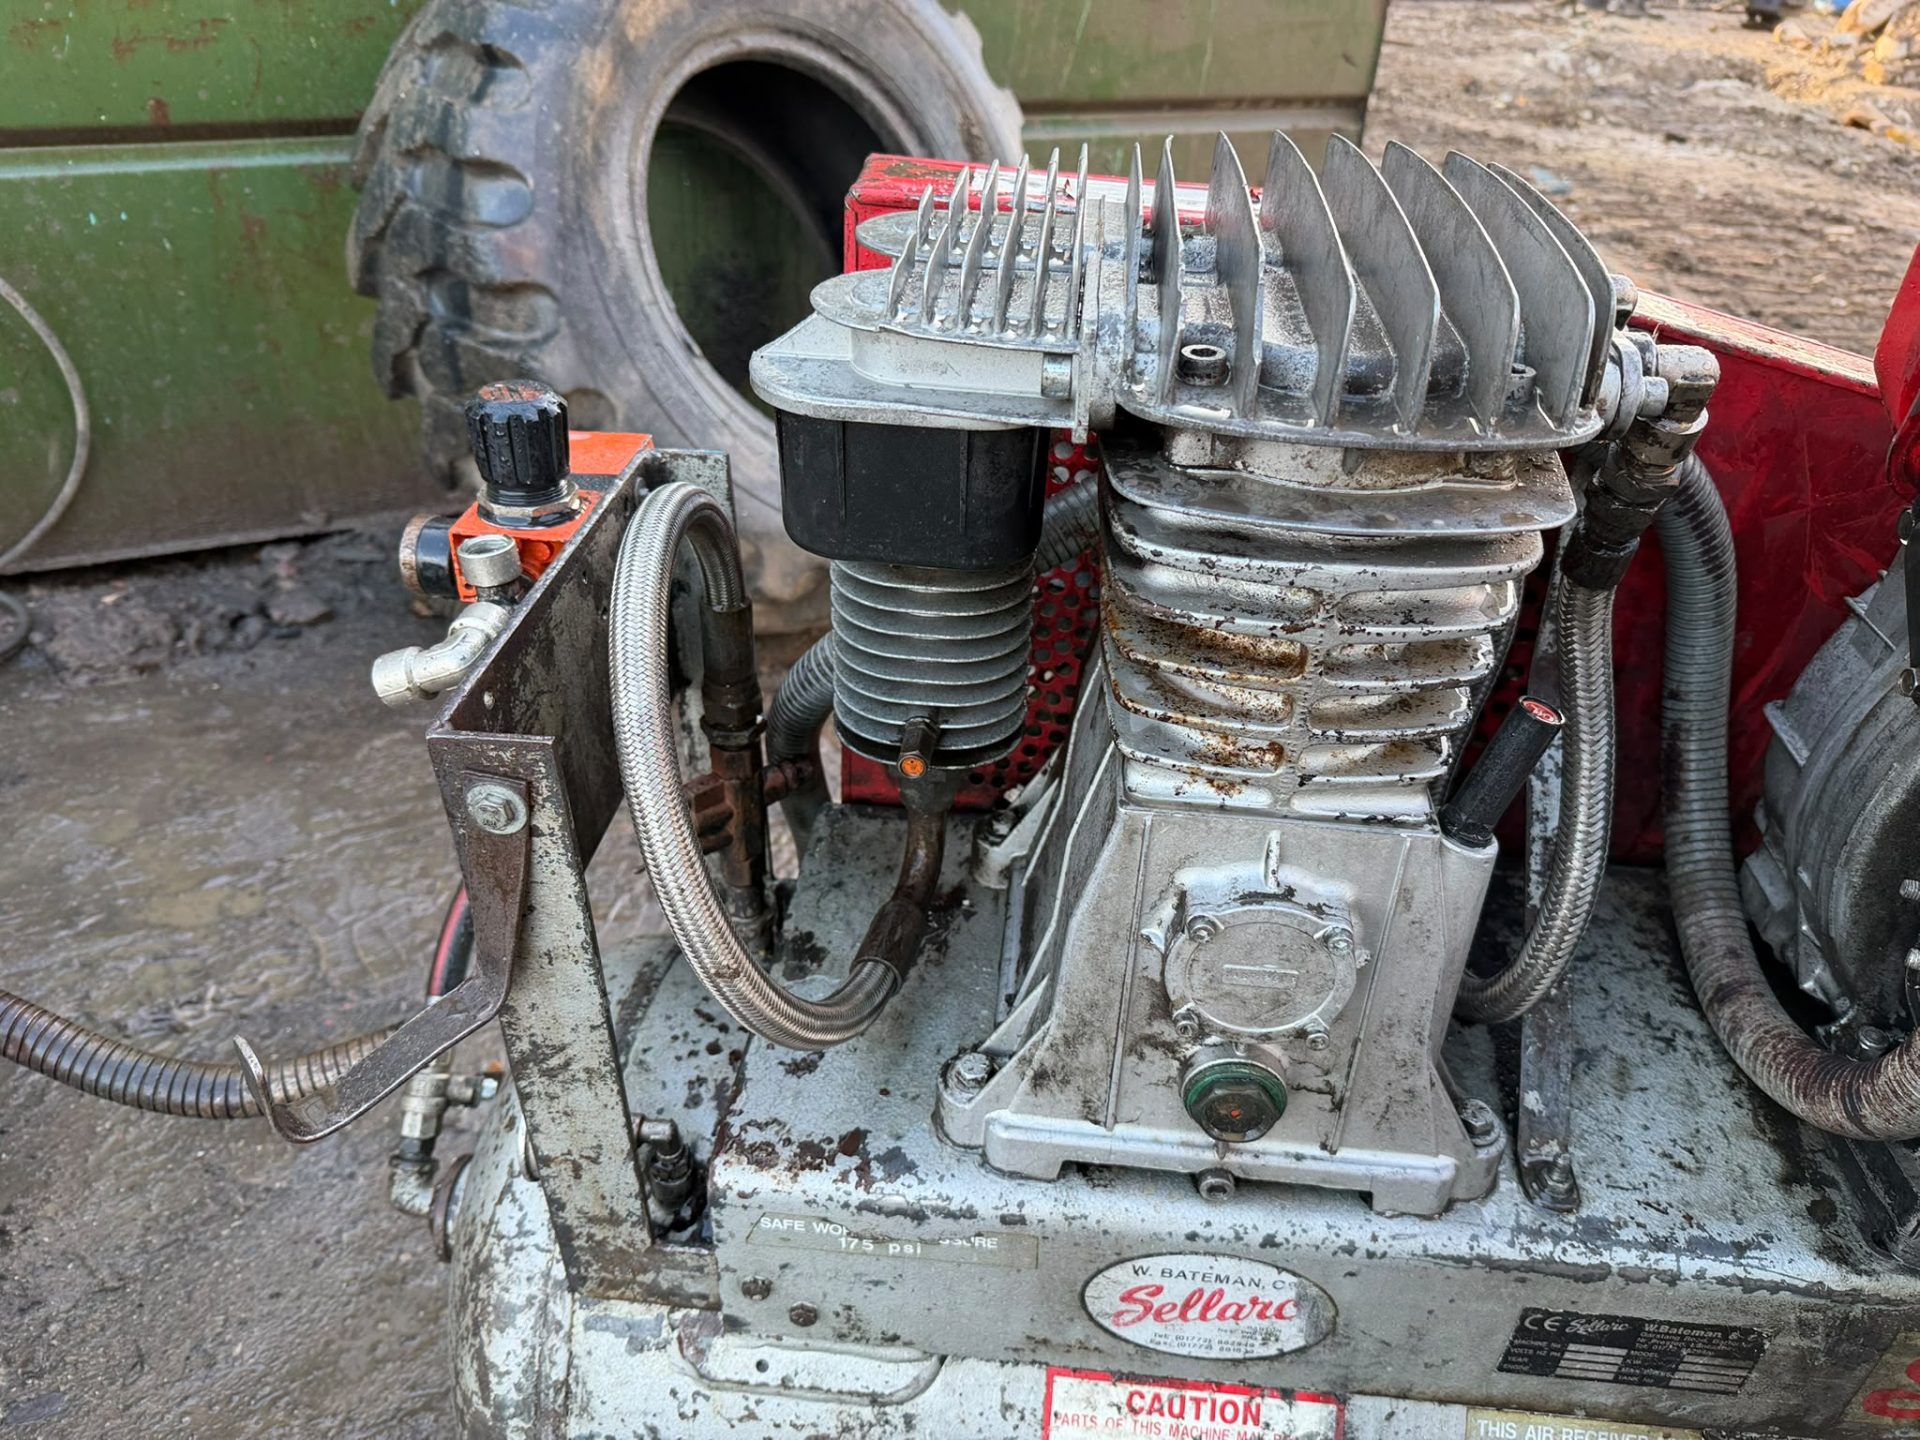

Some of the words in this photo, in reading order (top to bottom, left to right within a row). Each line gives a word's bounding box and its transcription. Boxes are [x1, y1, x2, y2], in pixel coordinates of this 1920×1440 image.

[760, 1217, 805, 1231] SAFE
[839, 1237, 874, 1251] 175
[888, 1242, 921, 1255] psi
[1523, 1314, 1562, 1332] CE
[1126, 1390, 1261, 1427] CAUTION
[1053, 1413, 1098, 1428] PARTS
[1105, 1417, 1124, 1429] OF
[1133, 1419, 1161, 1436] THIS
[1168, 1422, 1230, 1440] MACHINE
[1477, 1419, 1516, 1439] THIS
[1525, 1424, 1554, 1440] AIR
